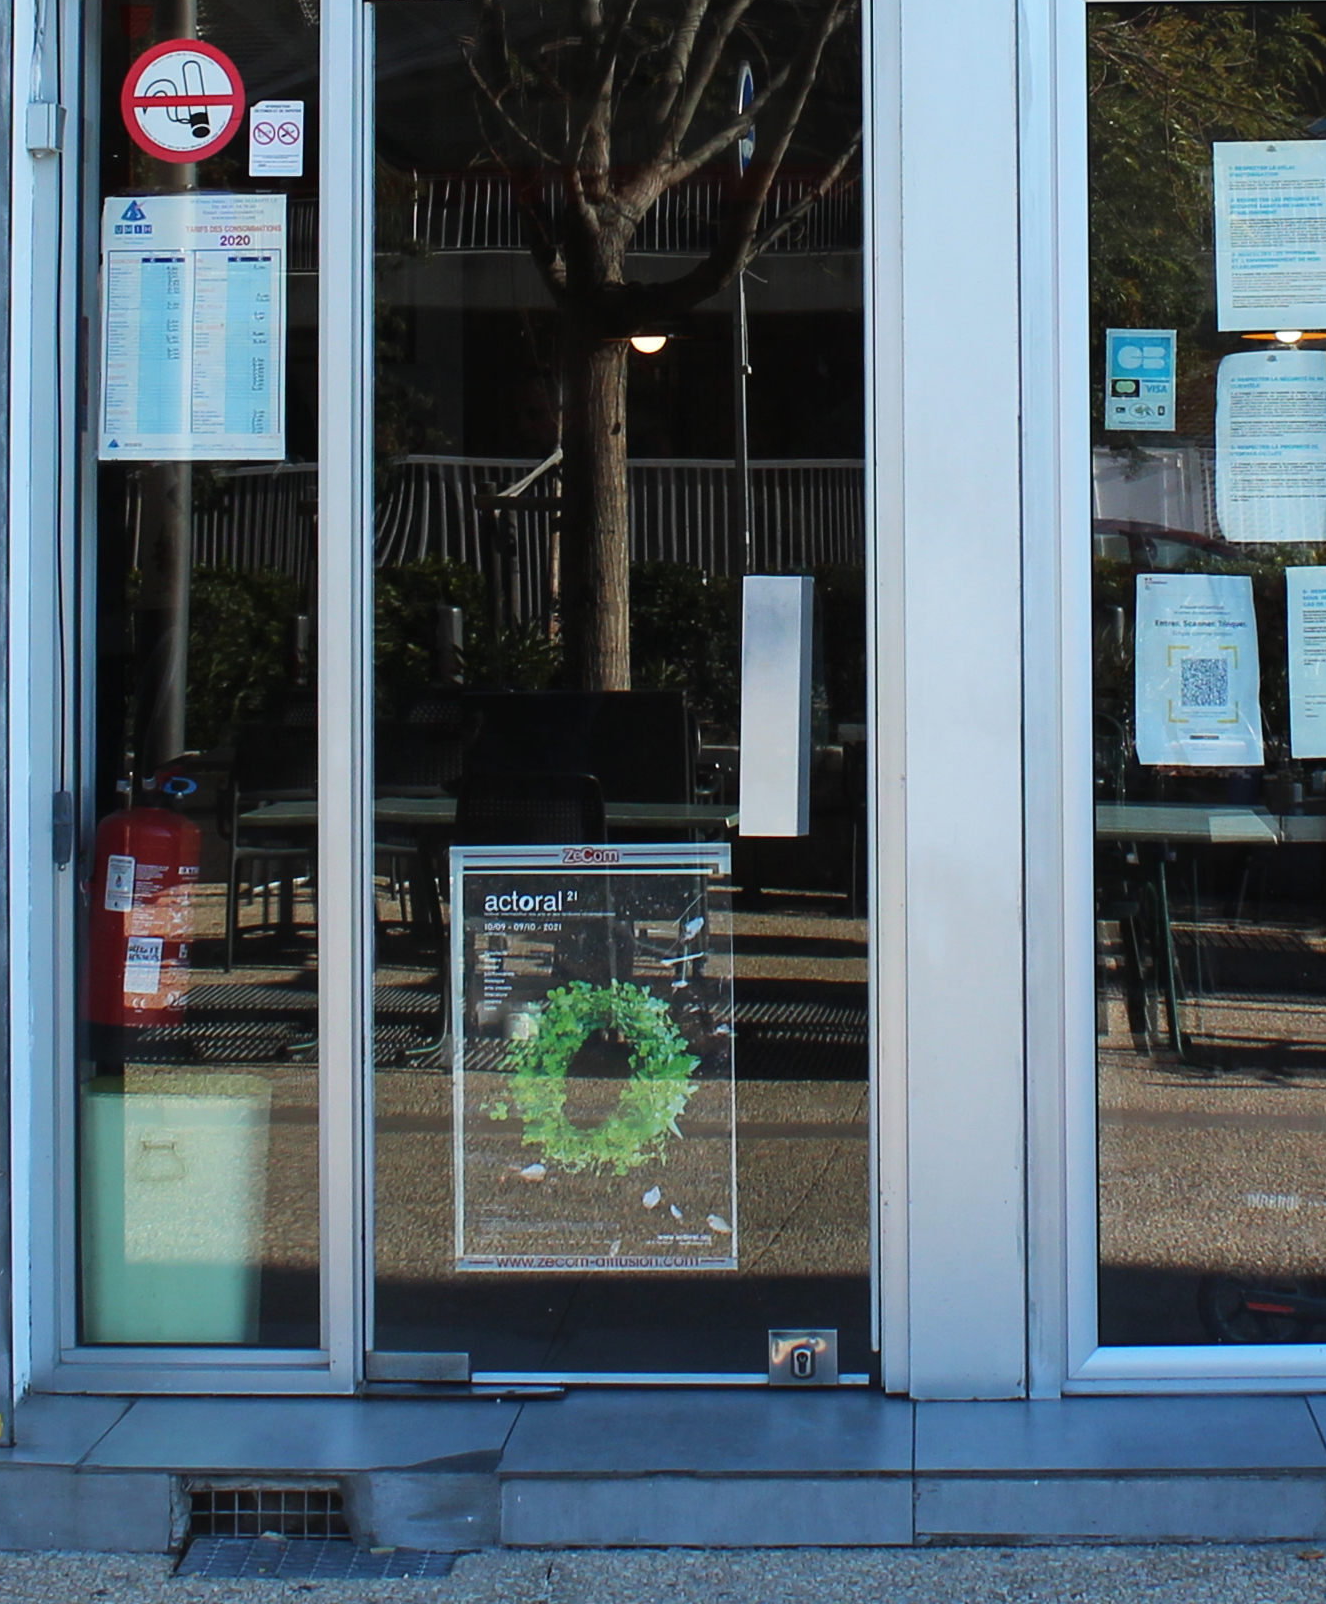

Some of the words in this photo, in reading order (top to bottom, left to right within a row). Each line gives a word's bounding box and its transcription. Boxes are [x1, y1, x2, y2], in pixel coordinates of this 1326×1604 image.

[219, 235, 252, 247] 2020
[1145, 384, 1168, 394] VISA
[562, 846, 620, 864] ZeCom
[484, 890, 563, 913] actoral
